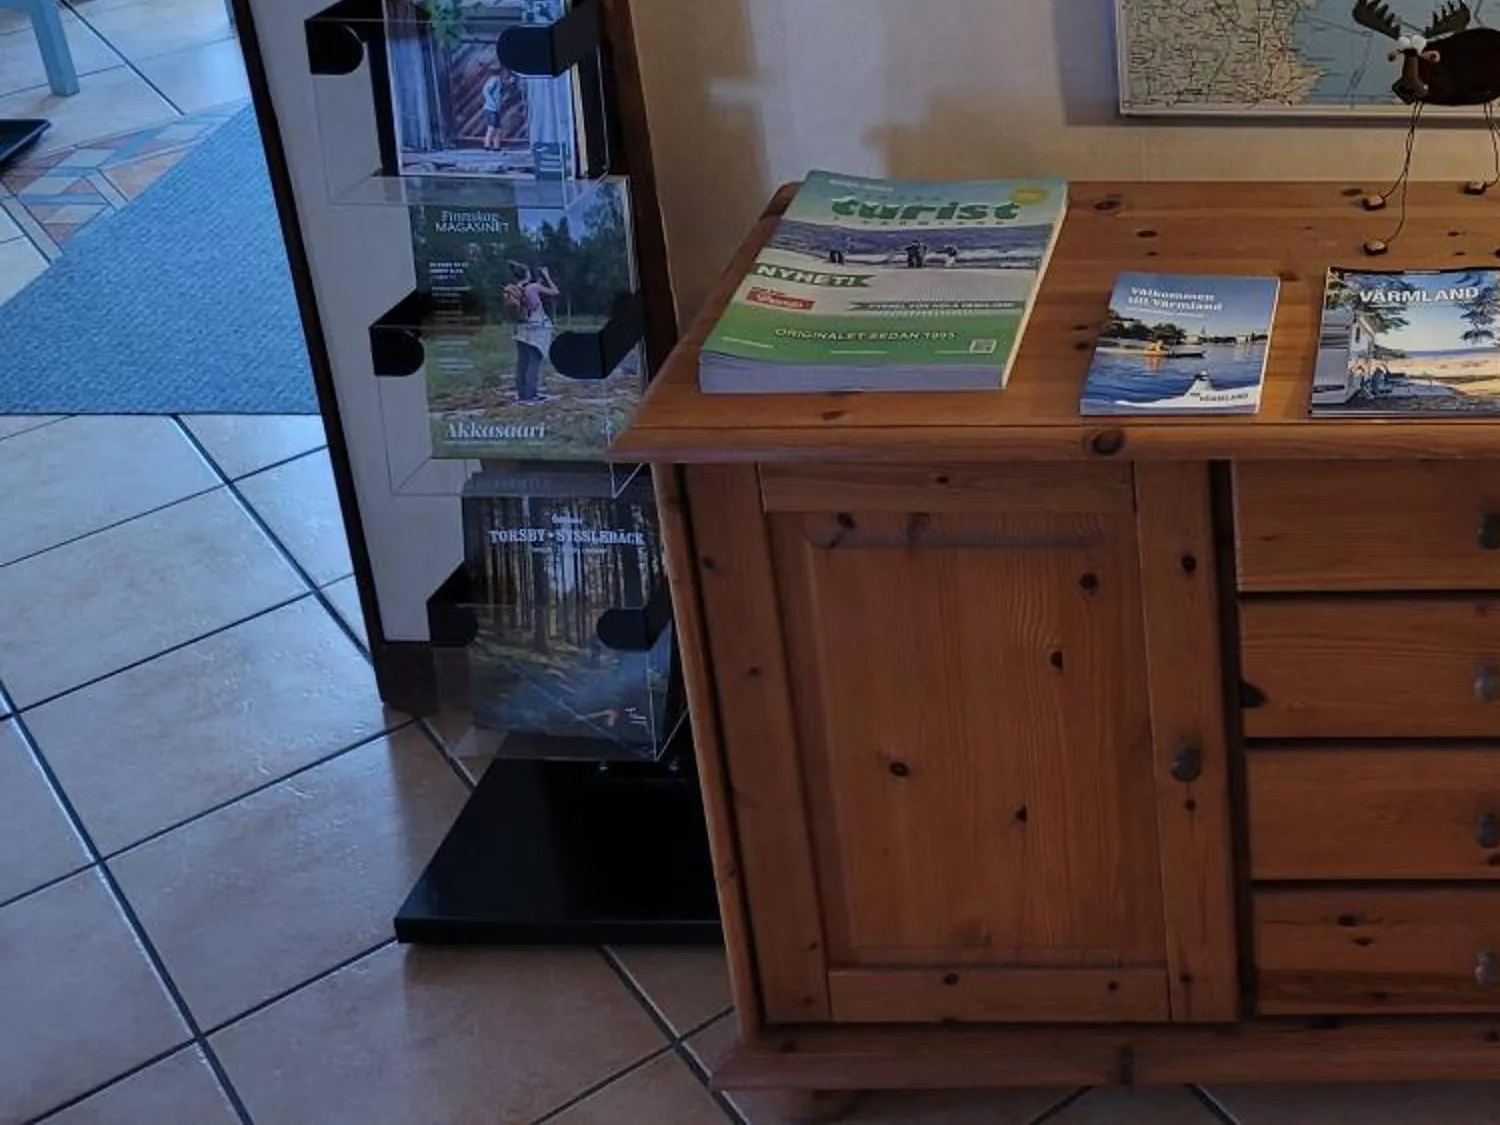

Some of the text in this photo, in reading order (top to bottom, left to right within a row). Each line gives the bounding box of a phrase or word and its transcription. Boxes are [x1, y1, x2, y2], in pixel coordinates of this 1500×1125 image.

[831, 196, 1021, 220] turist
[757, 264, 857, 286] NYHET!
[1131, 286, 1214, 300] Välkommen
[1358, 286, 1480, 303] VÄRMLAND
[1128, 296, 1223, 311] till Värmland
[775, 329, 866, 340] ORIGINALET
[488, 528, 645, 545] TORSBY SYSSLEBÄCK
